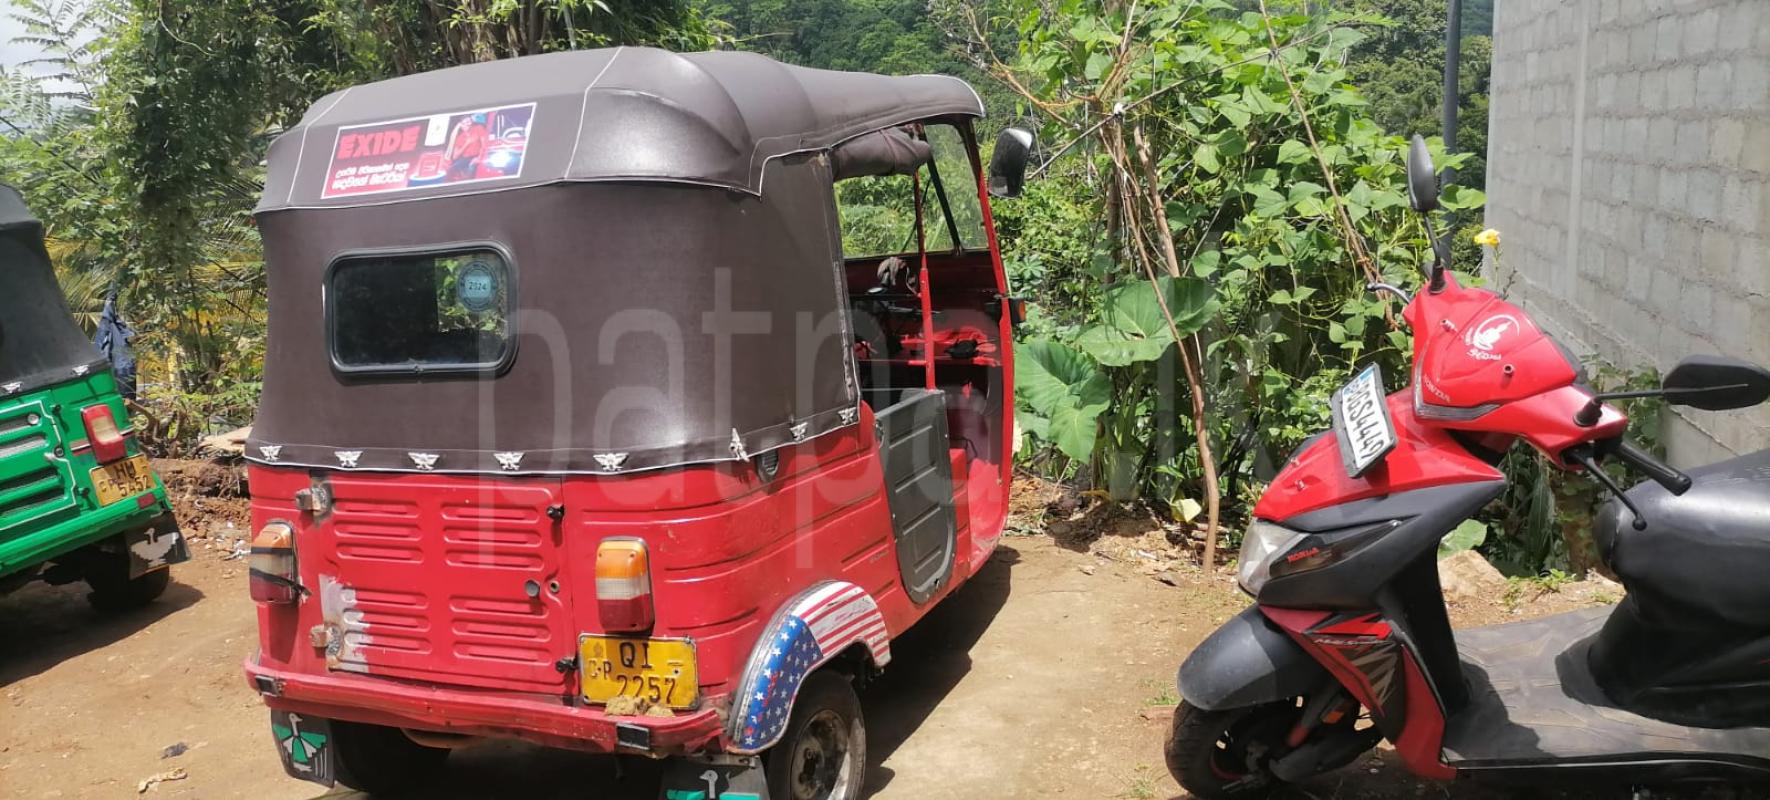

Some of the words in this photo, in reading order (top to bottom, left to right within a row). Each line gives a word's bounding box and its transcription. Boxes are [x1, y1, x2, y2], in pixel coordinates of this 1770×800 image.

[336, 125, 421, 160] EXIDE
[619, 641, 652, 669] QI
[616, 674, 676, 704] 2257
